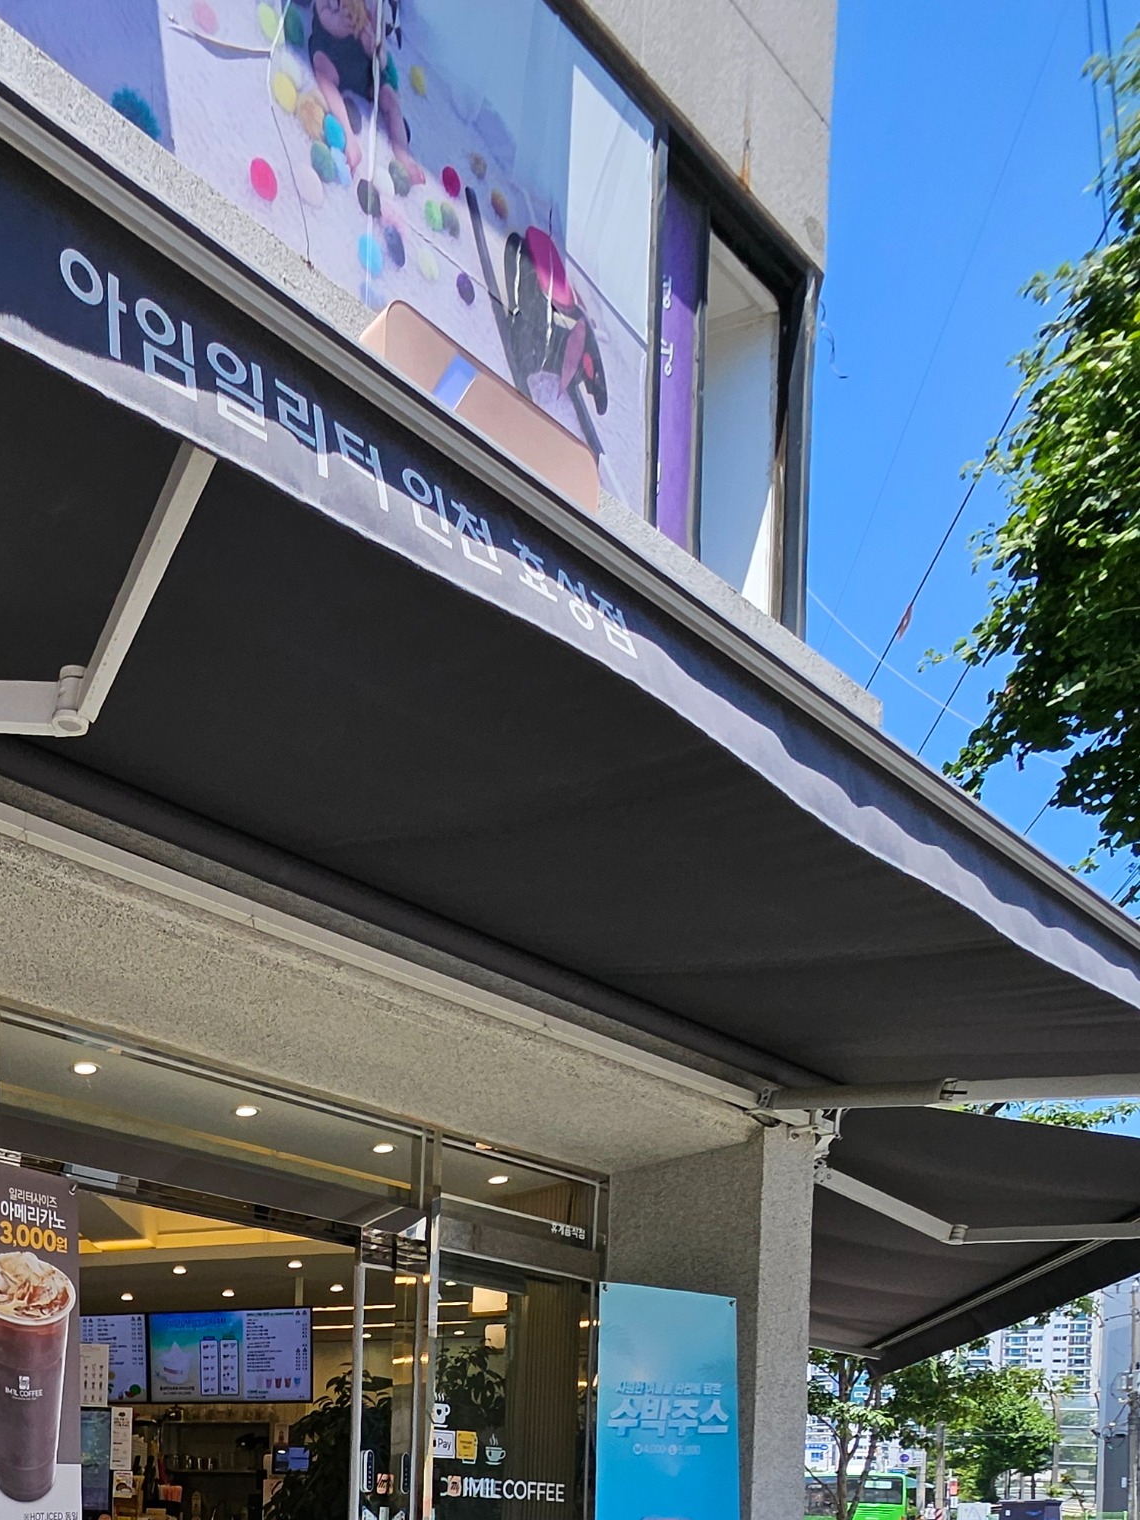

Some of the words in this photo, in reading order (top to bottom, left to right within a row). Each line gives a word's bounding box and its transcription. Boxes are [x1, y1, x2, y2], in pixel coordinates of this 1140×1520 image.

[59, 247, 390, 513] 아임일리터
[401, 467, 503, 576] 인천
[512, 536, 639, 659] 효성점
[9, 1187, 58, 1208] 일리터사이즈
[0, 1200, 67, 1230] 아메리카노
[0, 1220, 68, 1253] 3,000원
[607, 1398, 730, 1438] 수박주스
[503, 1479, 565, 1503] COFFEE
